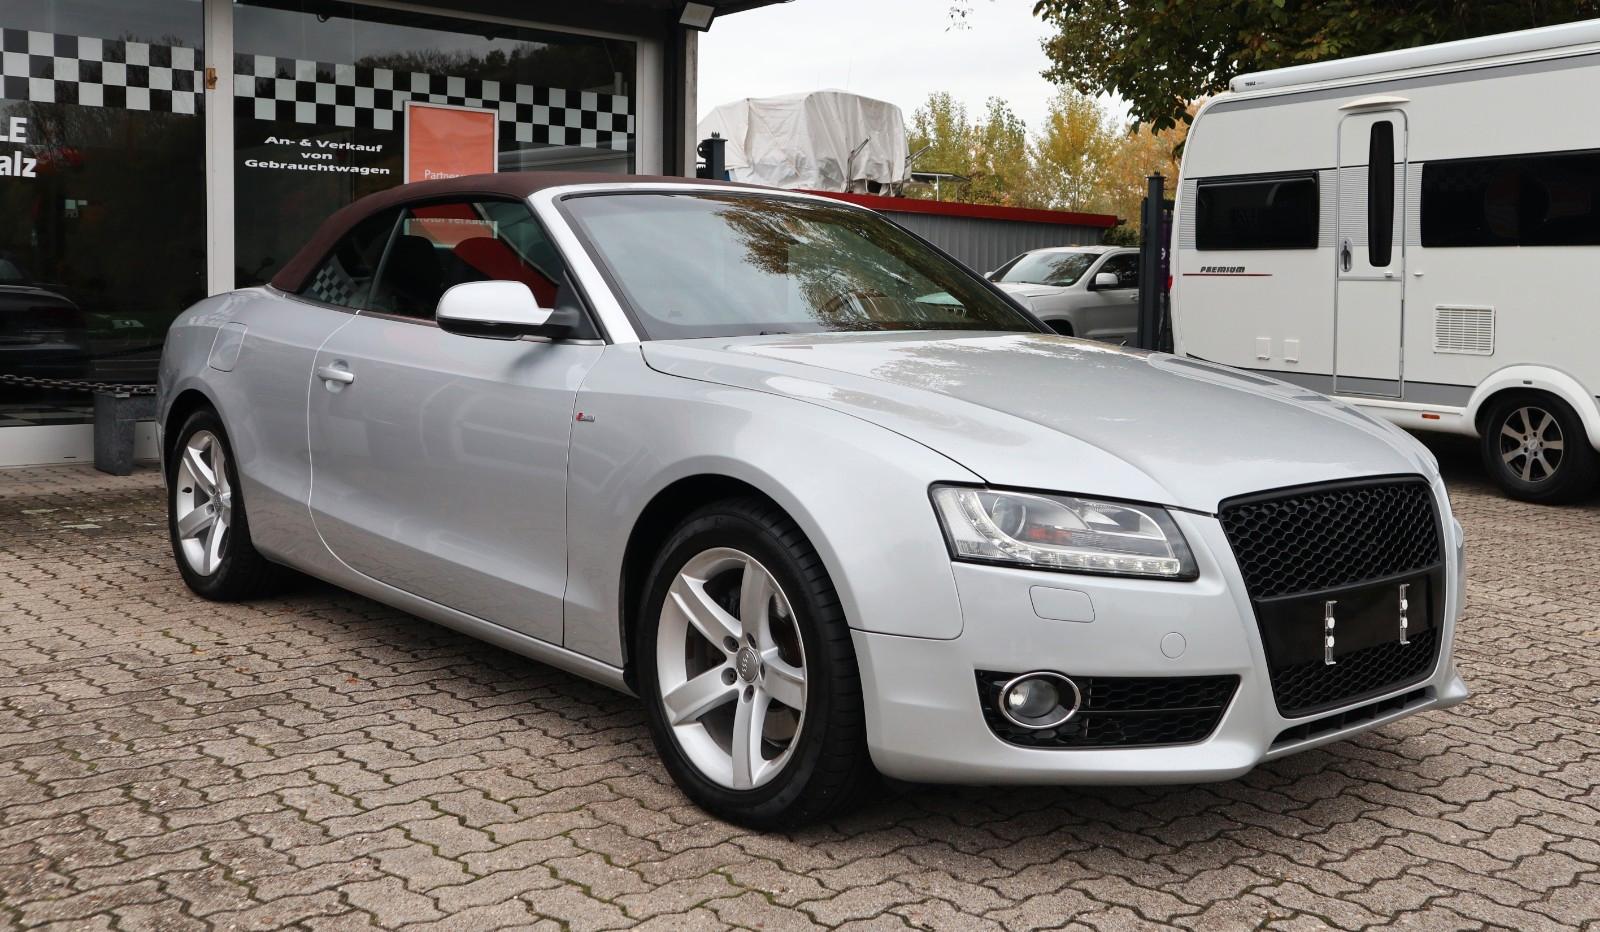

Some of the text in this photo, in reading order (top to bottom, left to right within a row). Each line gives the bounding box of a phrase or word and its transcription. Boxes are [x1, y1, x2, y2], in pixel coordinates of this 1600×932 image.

[264, 136, 383, 152] An- & Verkauf
[300, 152, 333, 160] von
[244, 159, 391, 175] Gebrauchtwagen
